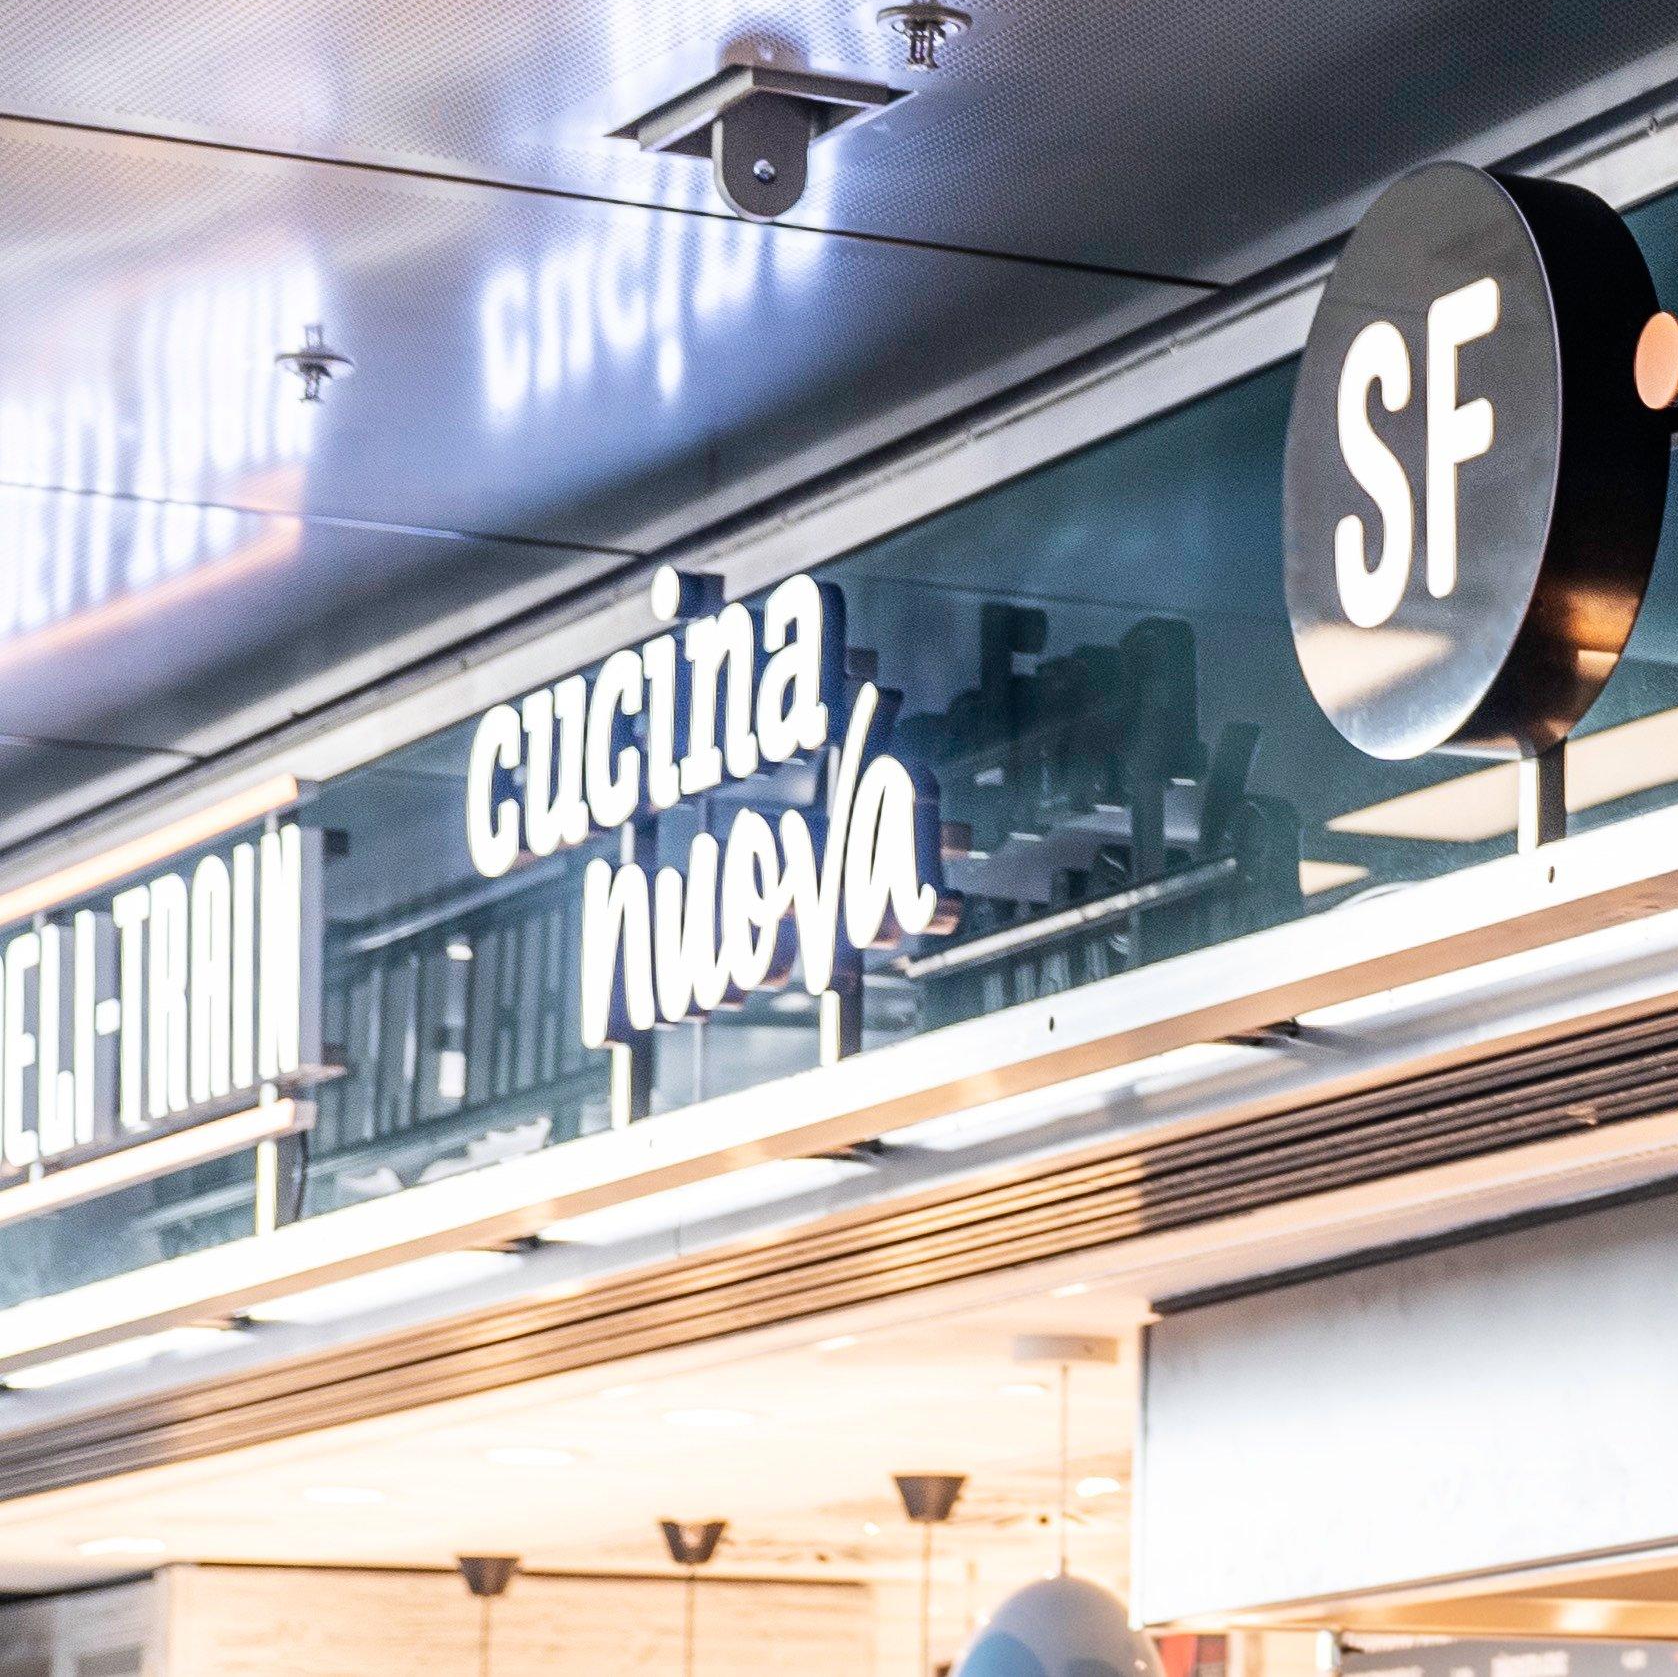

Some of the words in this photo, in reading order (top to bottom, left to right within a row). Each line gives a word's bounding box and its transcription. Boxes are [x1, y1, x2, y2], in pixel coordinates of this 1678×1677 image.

[1333, 275, 1500, 629] SF
[466, 565, 828, 877] cucina
[580, 682, 937, 1049] nuova
[0, 823, 301, 1167] ELI-TRAIN
